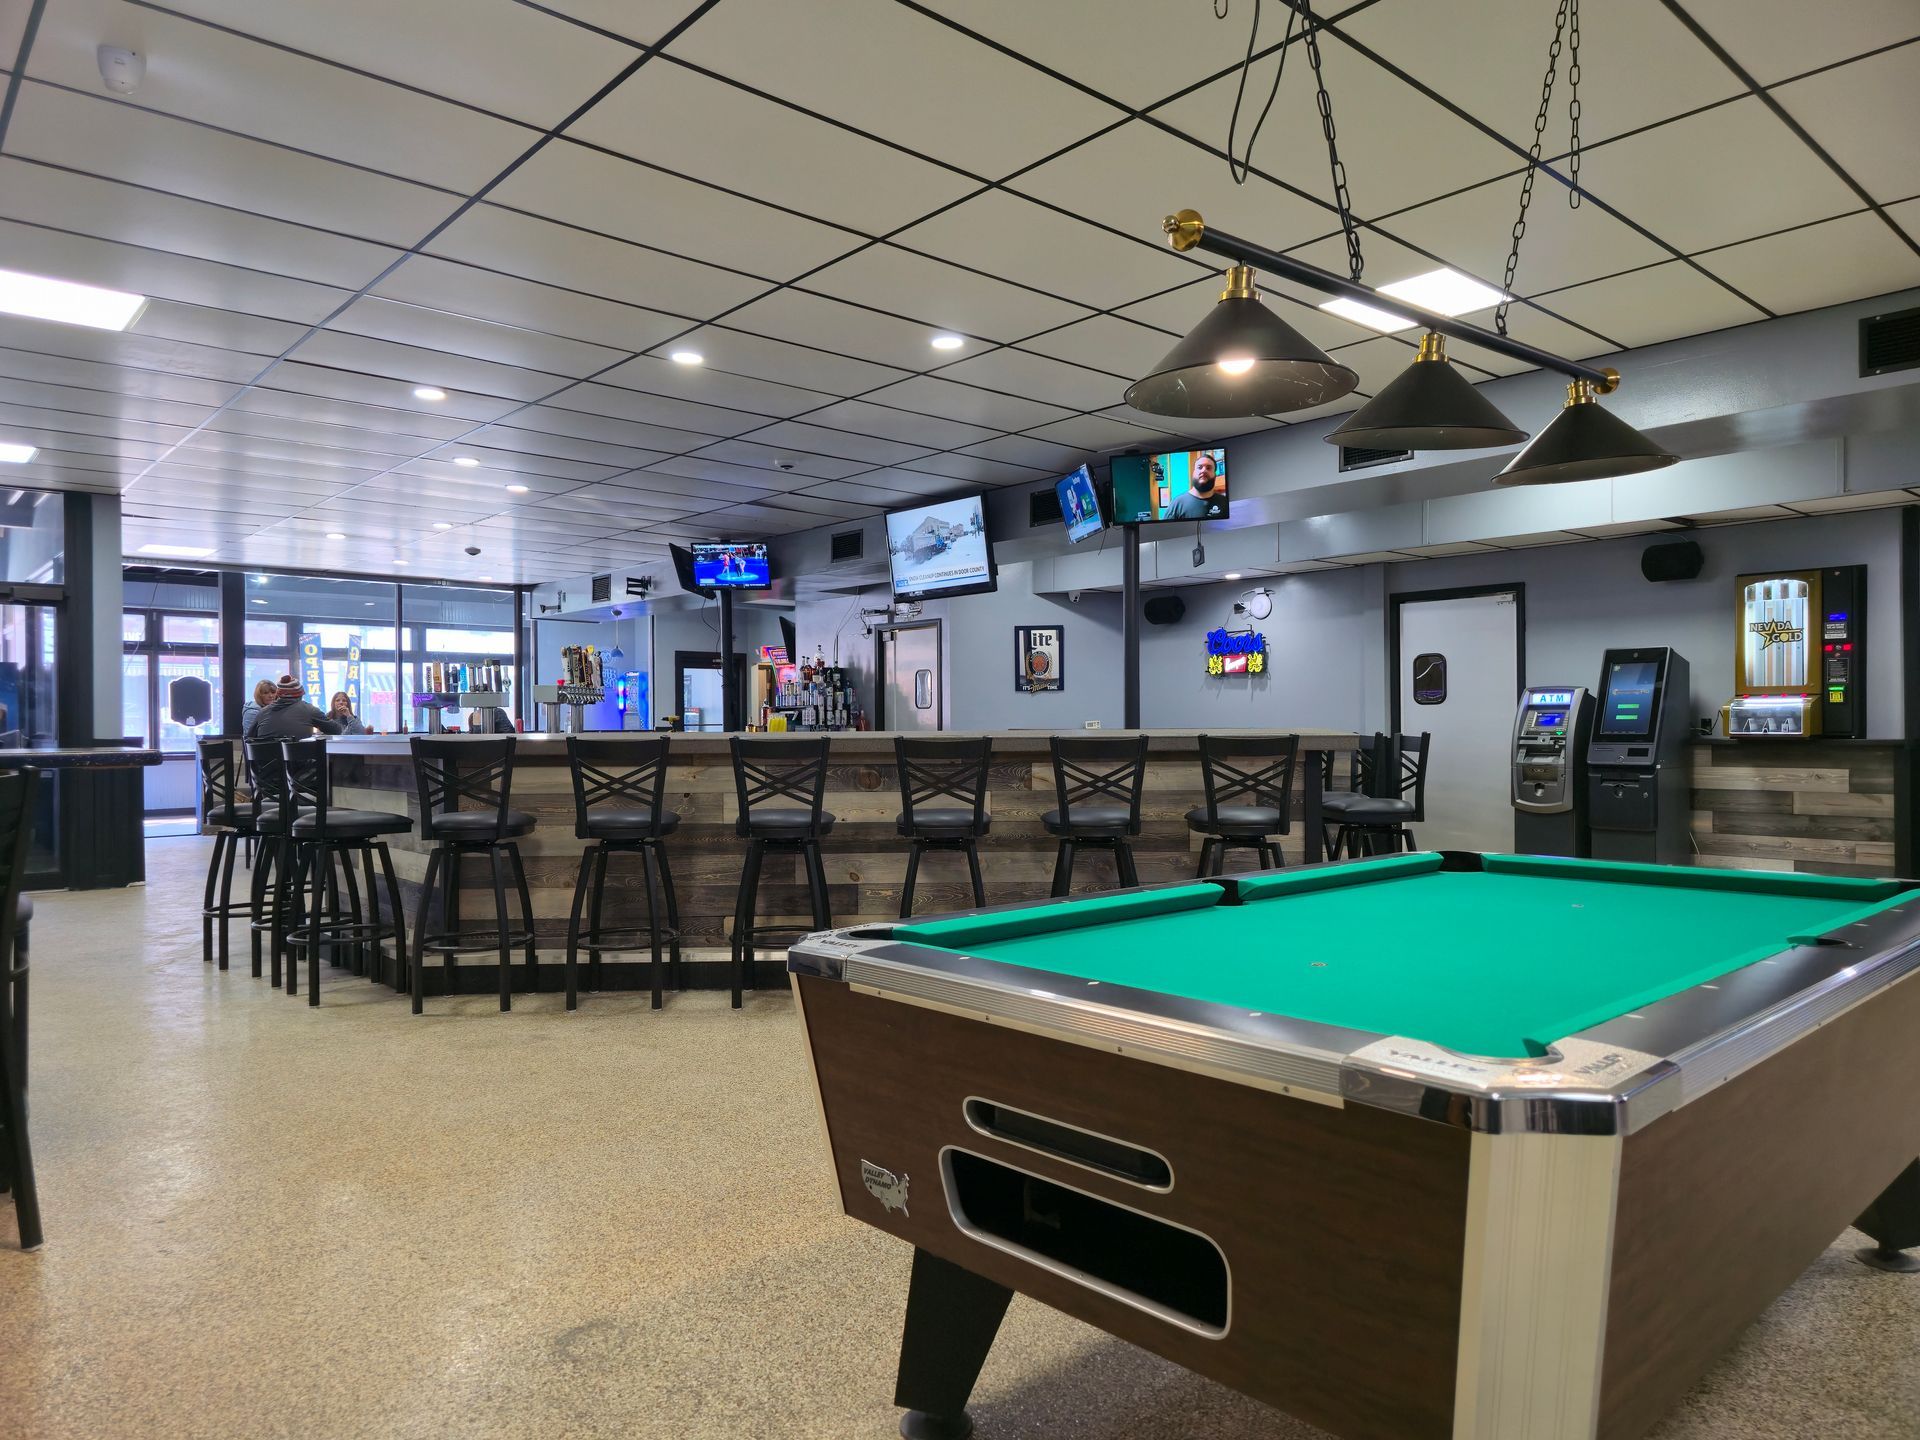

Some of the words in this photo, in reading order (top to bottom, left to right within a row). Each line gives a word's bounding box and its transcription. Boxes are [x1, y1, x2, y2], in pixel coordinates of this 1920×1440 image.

[934, 570, 953, 578] CONTINUES
[969, 565, 985, 574] COUNTY
[1750, 619, 1792, 632] NEVADA
[1207, 628, 1264, 656] Coors
[1771, 632, 1802, 642] GOLD
[1540, 694, 1564, 702] ATM
[1574, 1052, 1623, 1074] VALLEY
[864, 1168, 885, 1178] VALLEY
[865, 1177, 892, 1189] DYNAMO
